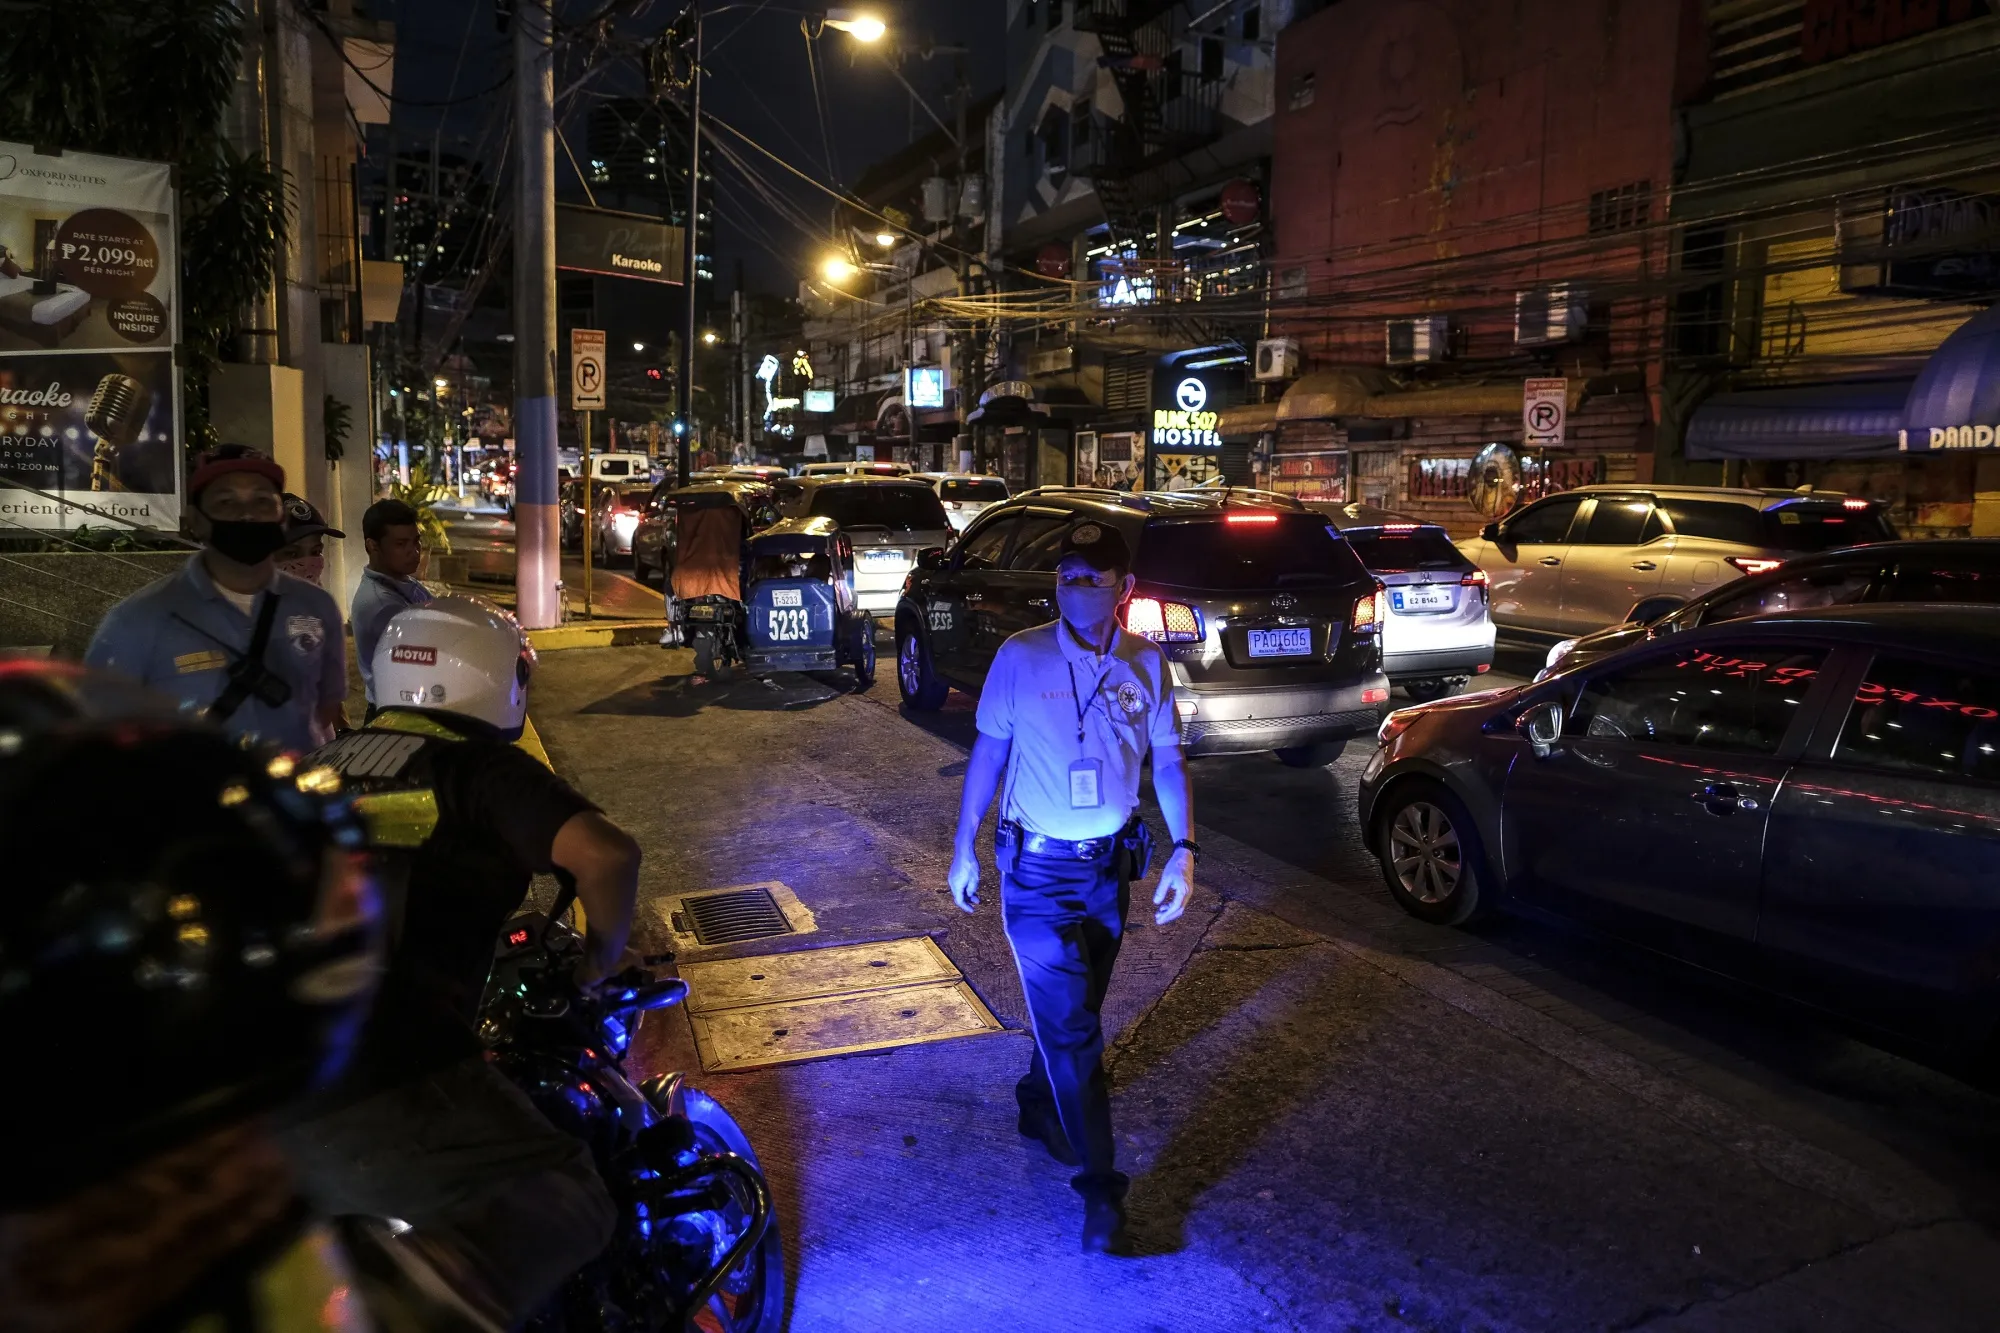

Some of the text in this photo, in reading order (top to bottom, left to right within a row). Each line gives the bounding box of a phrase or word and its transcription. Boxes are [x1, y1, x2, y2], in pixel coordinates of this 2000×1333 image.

[20, 167, 107, 186] OXFORD SUITES
[72, 231, 145, 246] RATE STARTS AT
[611, 253, 663, 273] Karaoke
[83, 266, 136, 277] PER NIGHT
[113, 311, 160, 323] INQUIRE
[119, 322, 156, 333] INSIDE
[1154, 428, 1222, 446] HOSTEL
[17, 463, 42, 471] 12:00
[774, 595, 799, 606] T-5233
[769, 609, 809, 641] 5233
[393, 648, 433, 662] MOTUL
